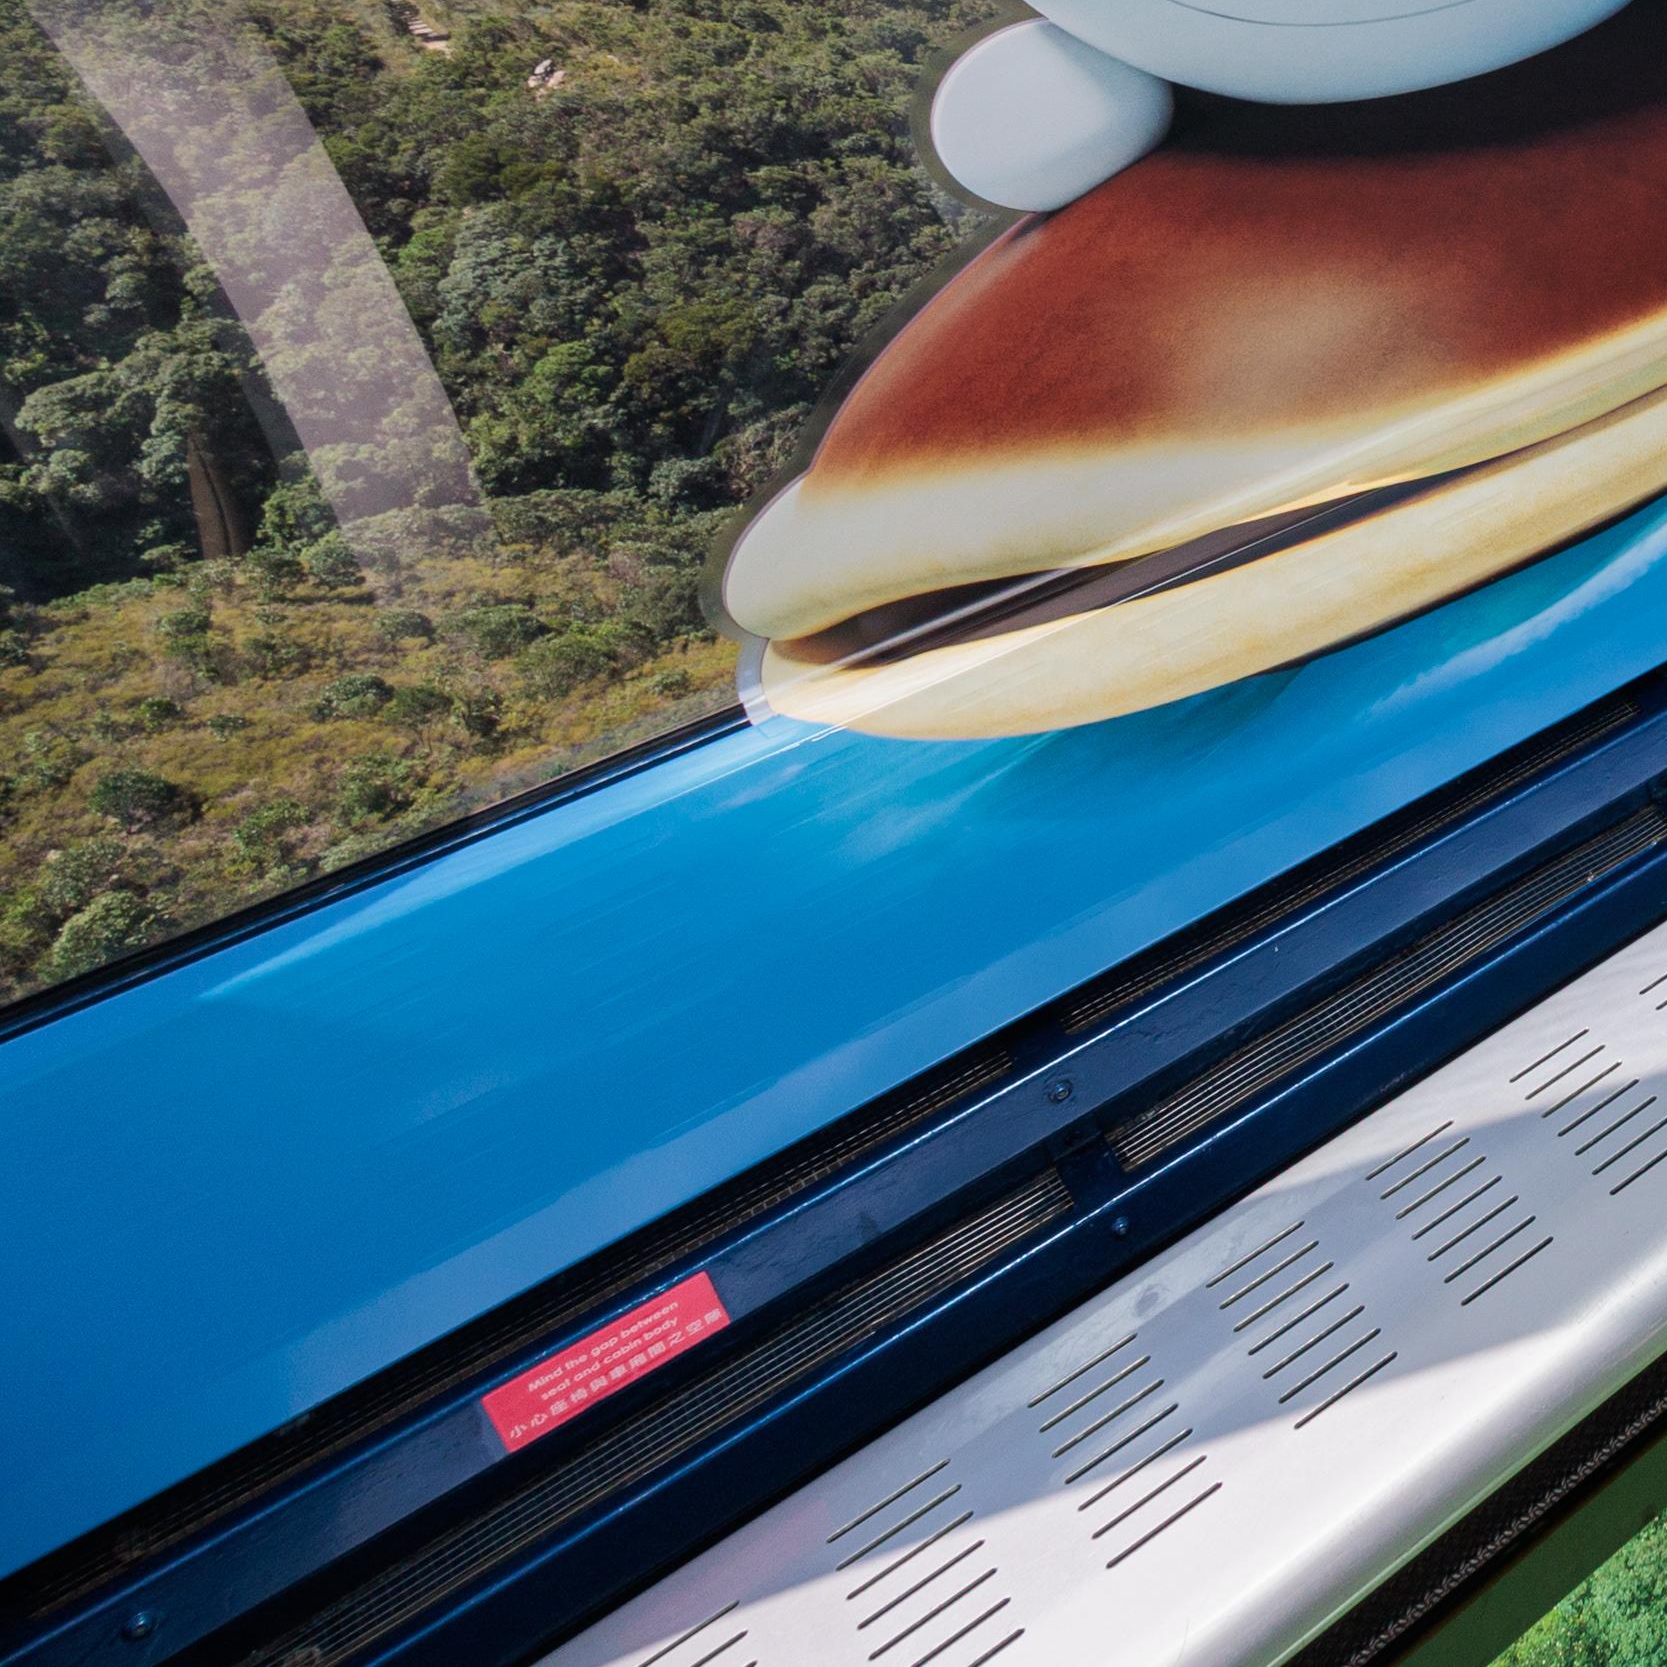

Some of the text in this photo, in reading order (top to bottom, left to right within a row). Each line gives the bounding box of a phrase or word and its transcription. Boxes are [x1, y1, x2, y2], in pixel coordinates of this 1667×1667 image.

[528, 1301, 678, 1392] Mind the gap between
[541, 1317, 678, 1401] seat and cabin body
